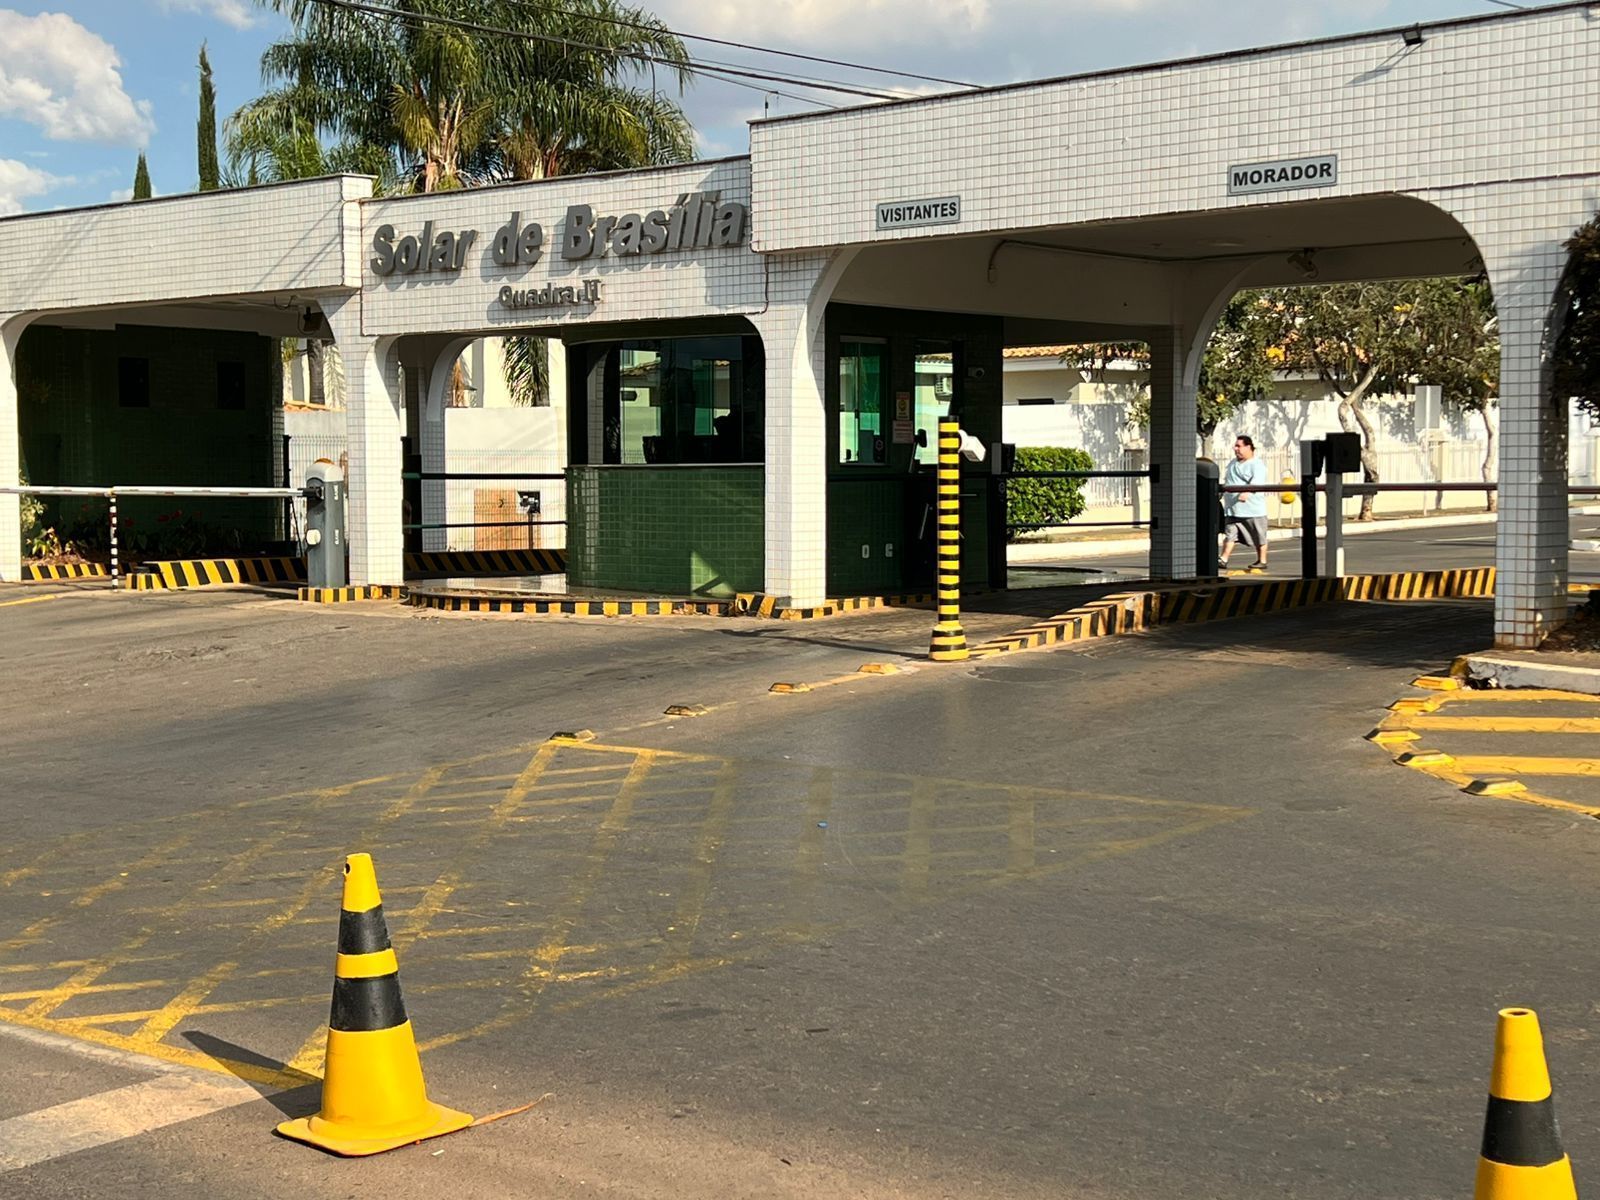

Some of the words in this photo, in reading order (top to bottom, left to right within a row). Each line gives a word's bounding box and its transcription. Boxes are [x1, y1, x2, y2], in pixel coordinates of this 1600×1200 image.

[1233, 162, 1333, 188] MORADOR
[880, 200, 958, 225] VISITANTES
[370, 220, 478, 276] Solar
[493, 211, 543, 265] de
[561, 190, 746, 260] Brasília
[499, 282, 575, 309] Quadra
